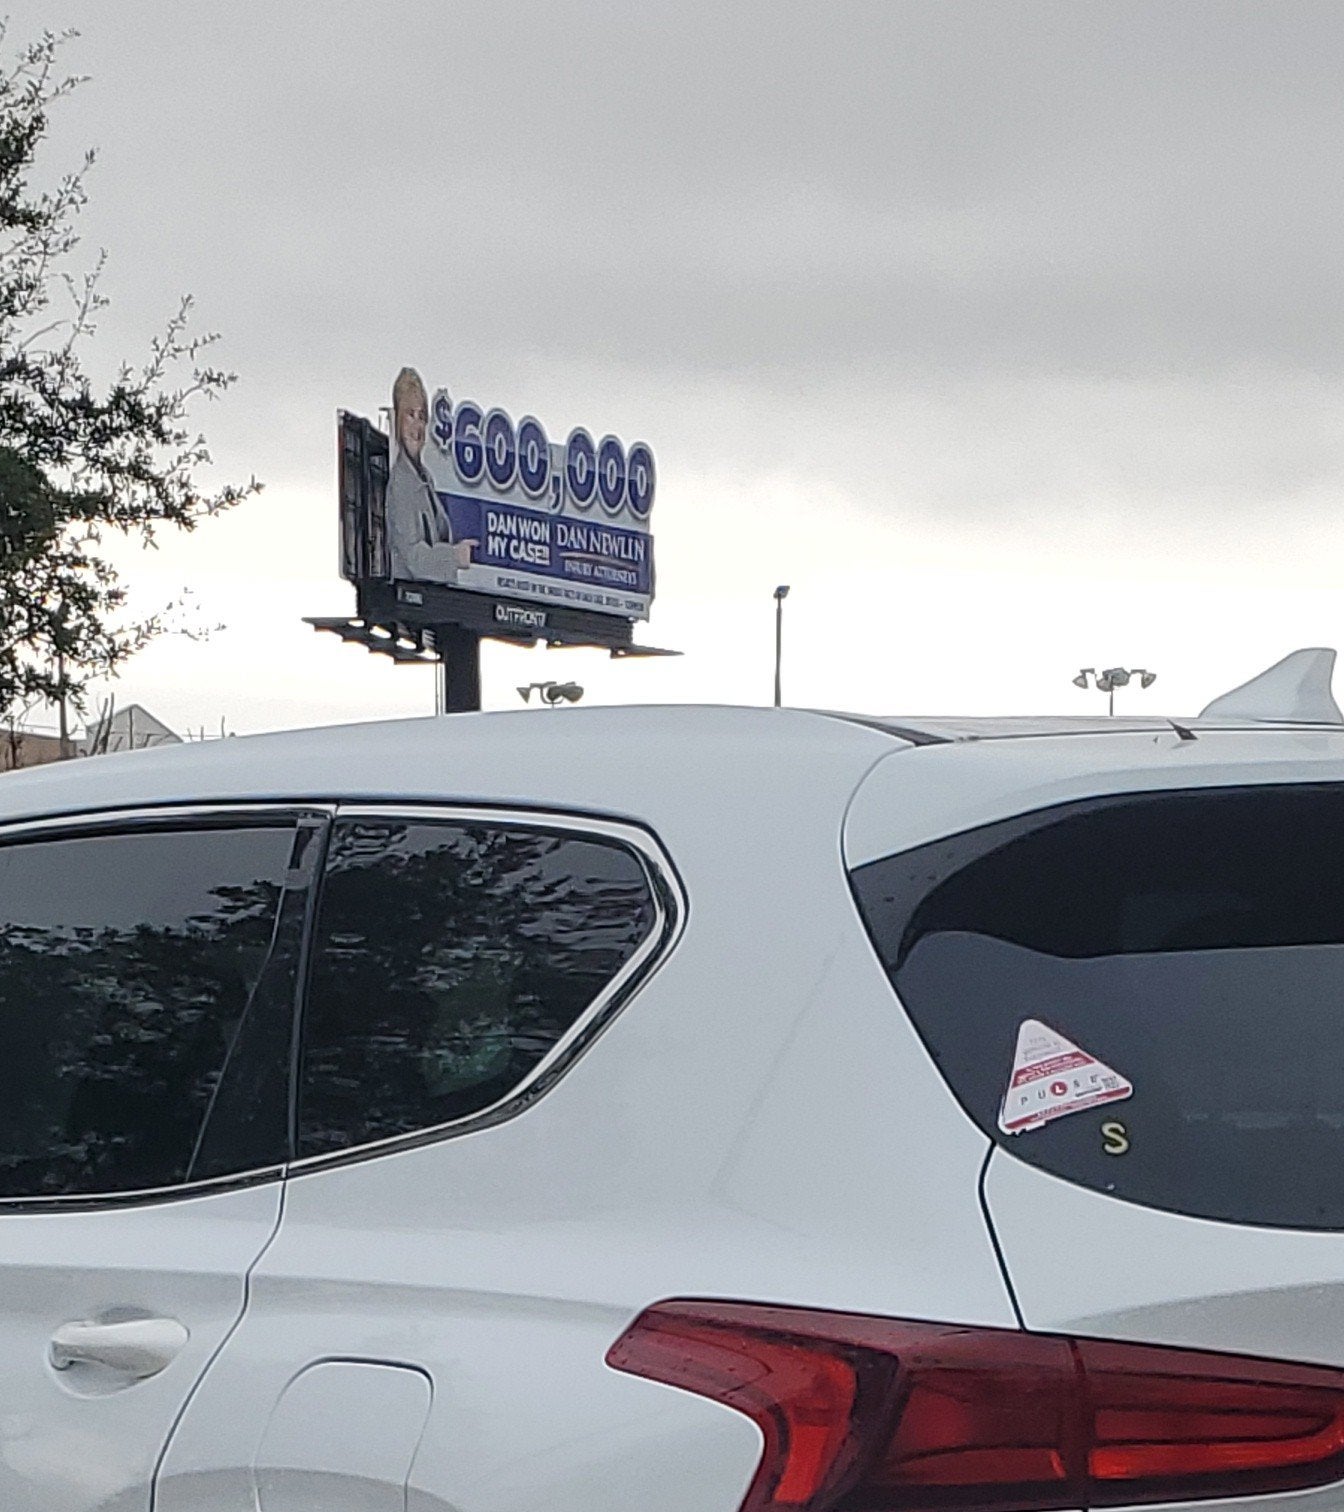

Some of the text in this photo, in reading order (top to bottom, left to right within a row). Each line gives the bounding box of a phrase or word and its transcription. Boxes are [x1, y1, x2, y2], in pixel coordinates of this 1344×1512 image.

[433, 388, 656, 516] $600,000
[487, 511, 550, 544] DAN WON
[556, 523, 645, 562] DAN NEWLIN
[487, 534, 508, 558] MY
[1101, 1122, 1129, 1154] S
